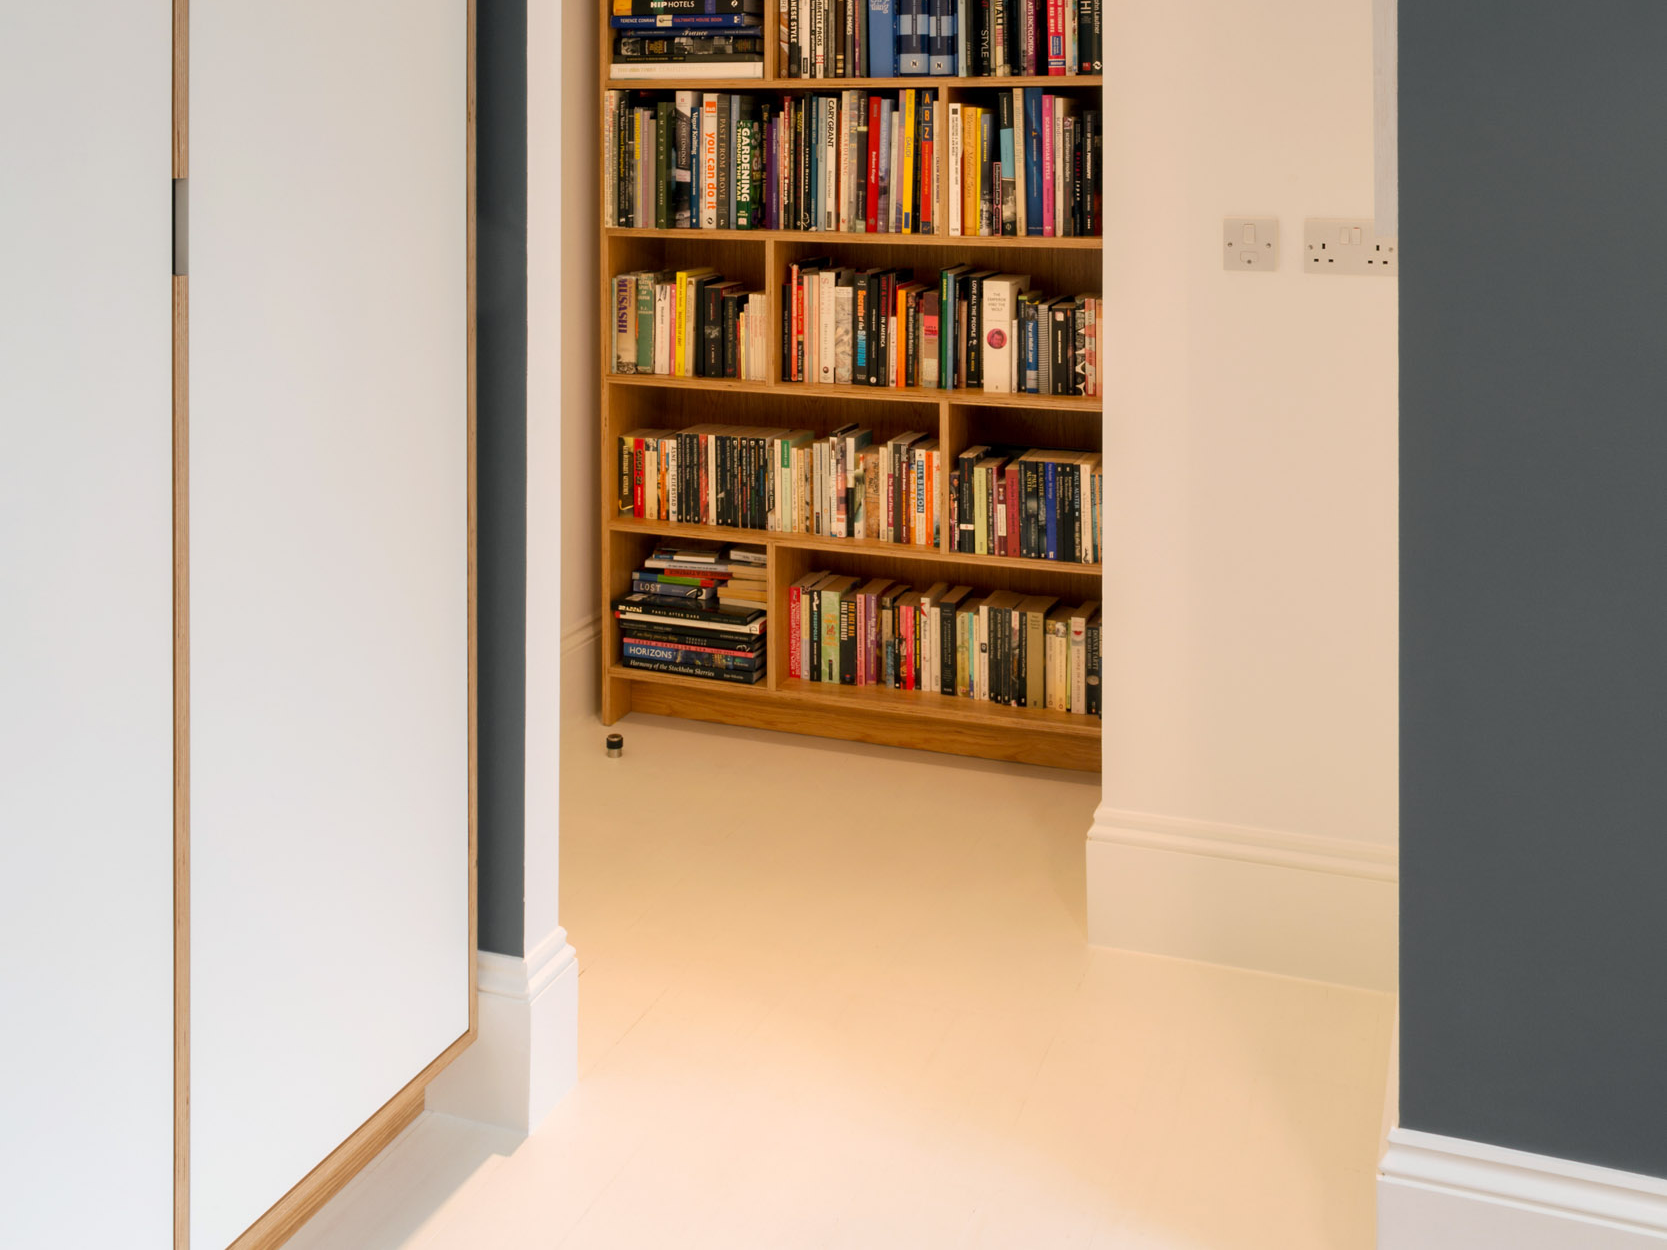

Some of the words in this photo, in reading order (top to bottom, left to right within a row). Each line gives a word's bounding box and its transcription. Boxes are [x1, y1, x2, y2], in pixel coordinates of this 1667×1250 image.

[667, 0, 695, 8] HOTELS
[790, 21, 798, 43] STYLE
[981, 30, 989, 58] STYLE
[705, 132, 717, 154] you
[707, 158, 715, 178] can
[741, 128, 750, 202] GARDENING
[707, 182, 717, 198] do
[707, 201, 717, 210] it
[617, 278, 628, 334] MUSASHI
[857, 330, 866, 367] SAMURAI
[639, 583, 662, 592] LOST
[629, 646, 673, 659] HORIZONS
[630, 659, 653, 670] Harmony
[653, 662, 659, 671] of
[660, 663, 668, 671] the
[668, 664, 694, 675] Stockholm
[695, 667, 715, 677] Skerries
